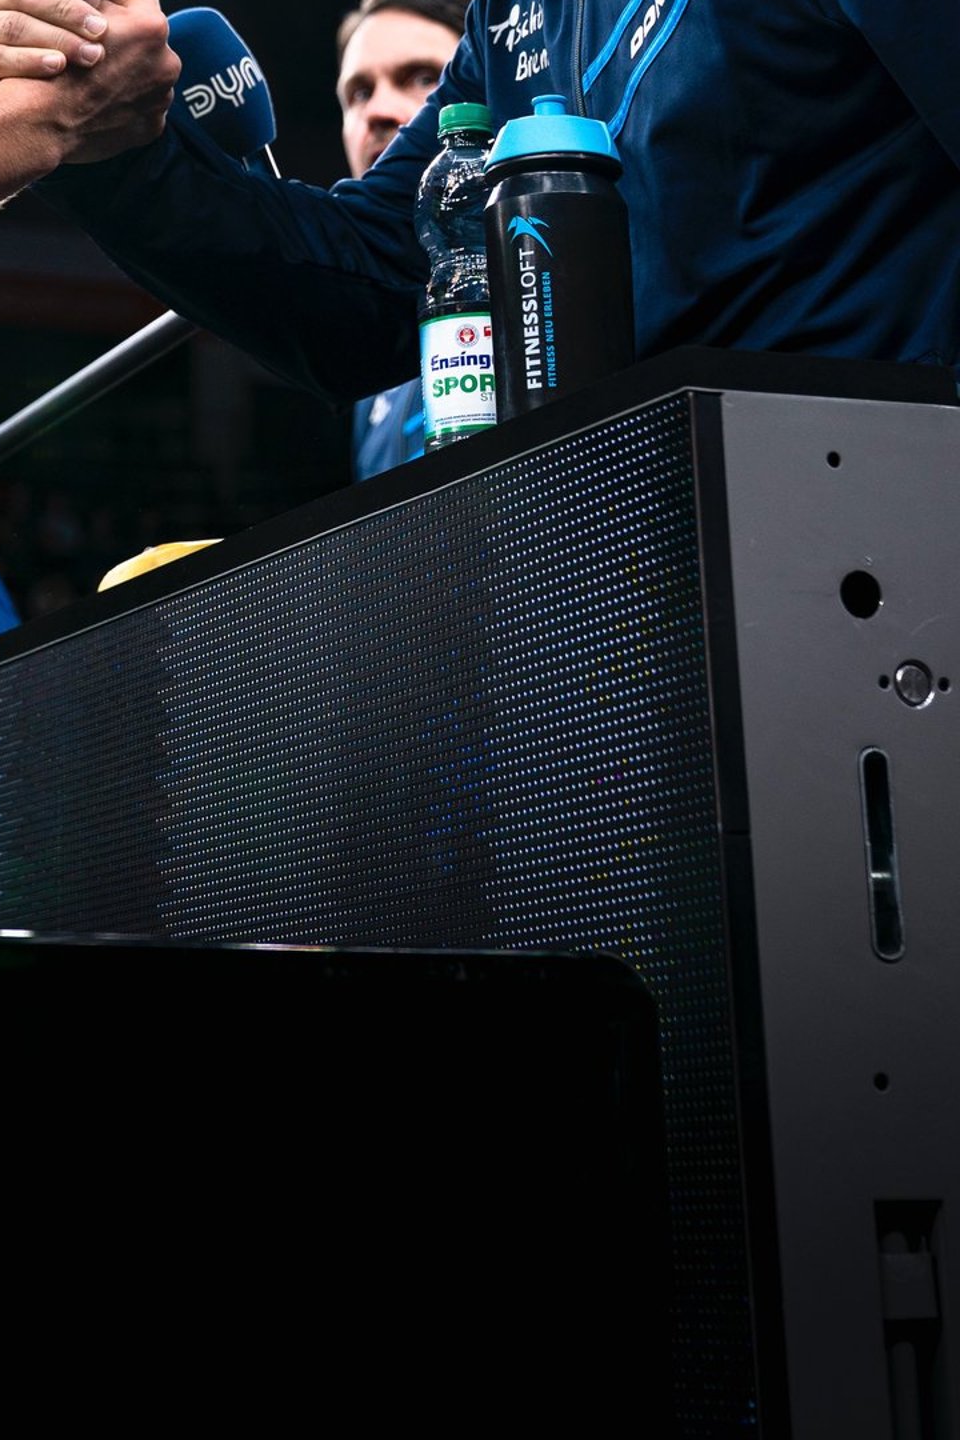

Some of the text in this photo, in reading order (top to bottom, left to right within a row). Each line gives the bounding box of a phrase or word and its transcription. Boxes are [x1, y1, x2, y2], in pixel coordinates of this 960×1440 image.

[431, 351, 494, 371] Ensing
[518, 248, 543, 390] FITNESSLOFT
[541, 271, 557, 388] FITNESS NEU ERLEBEN
